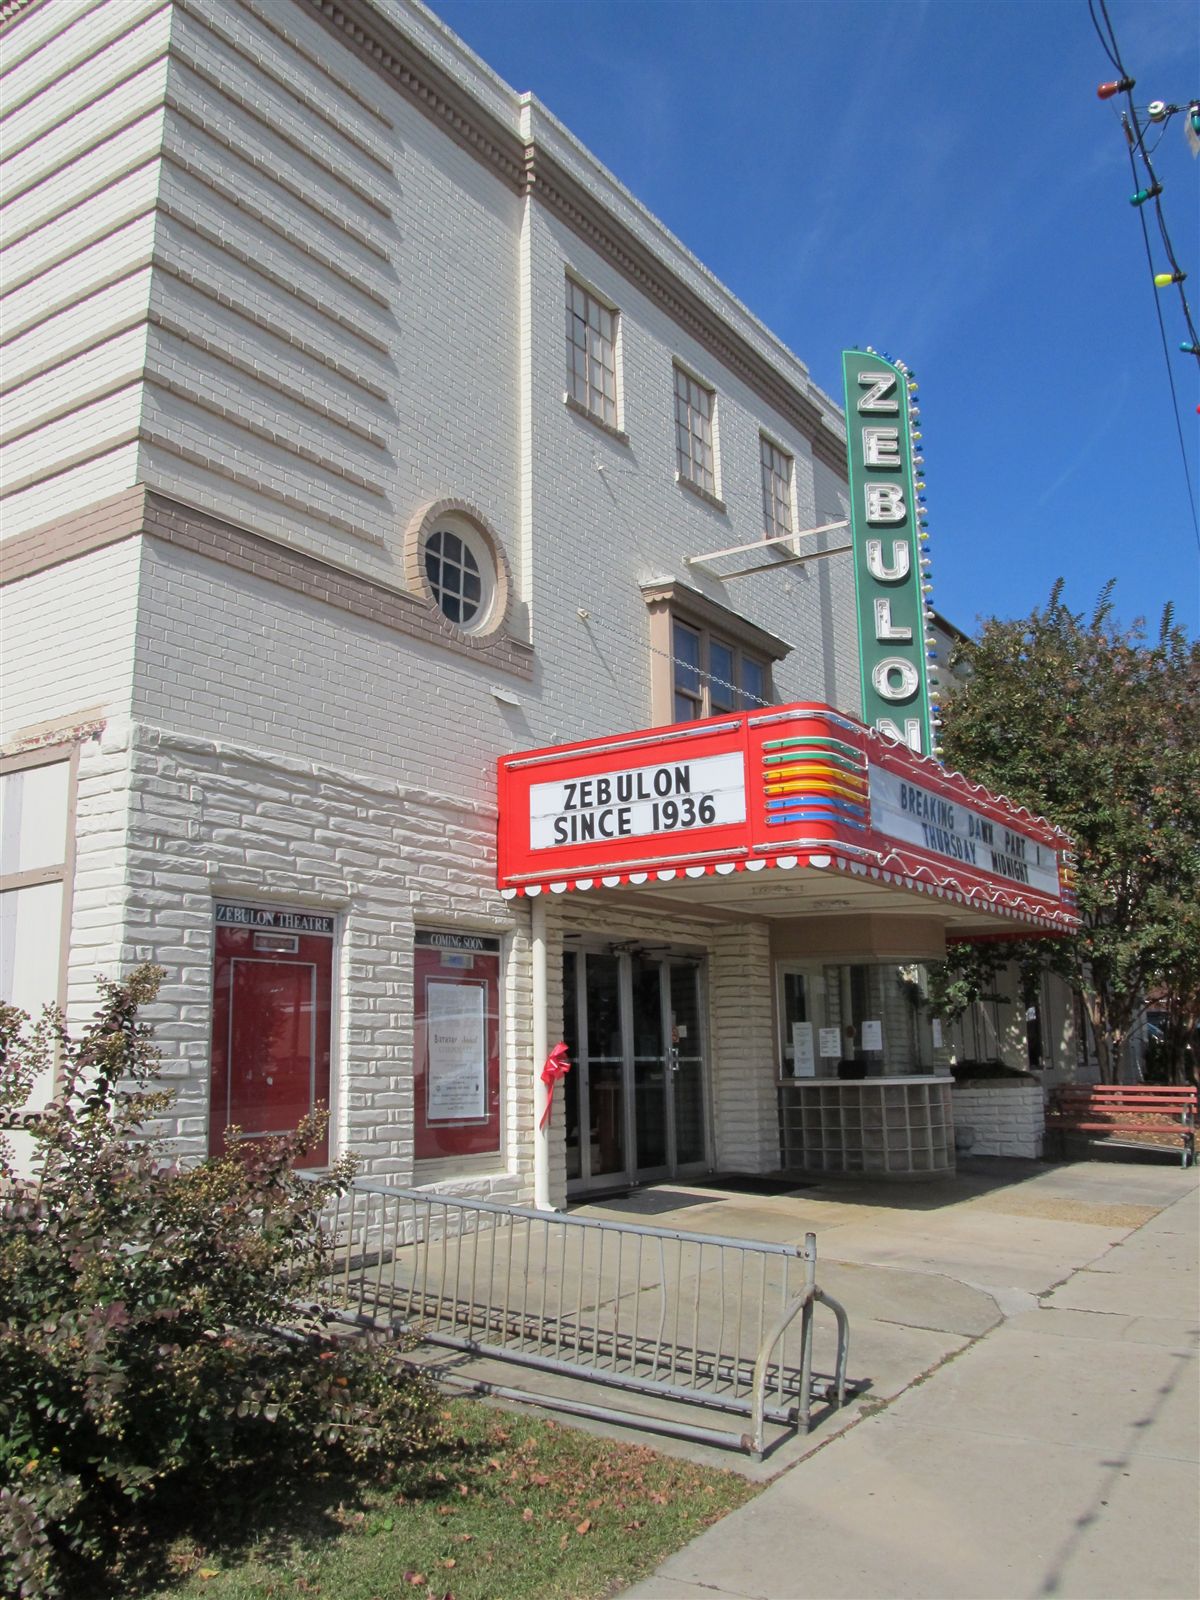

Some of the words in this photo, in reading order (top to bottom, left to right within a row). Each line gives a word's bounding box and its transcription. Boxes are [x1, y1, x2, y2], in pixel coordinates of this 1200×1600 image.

[857, 371, 921, 753] ZEBULON
[563, 765, 691, 811] ZEBULON
[554, 806, 632, 845] SINCE
[652, 795, 716, 832] 1936
[900, 783, 954, 830] BREAKING
[968, 814, 993, 846] DAWN
[1005, 831, 1026, 860] PART
[921, 822, 976, 865] THURSDAY
[991, 850, 1029, 884] MIDNIGHT
[217, 906, 275, 926] ZEBULON
[278, 912, 330, 931] THEATRE
[430, 933, 461, 948] COMING
[463, 937, 484, 949] SOON
